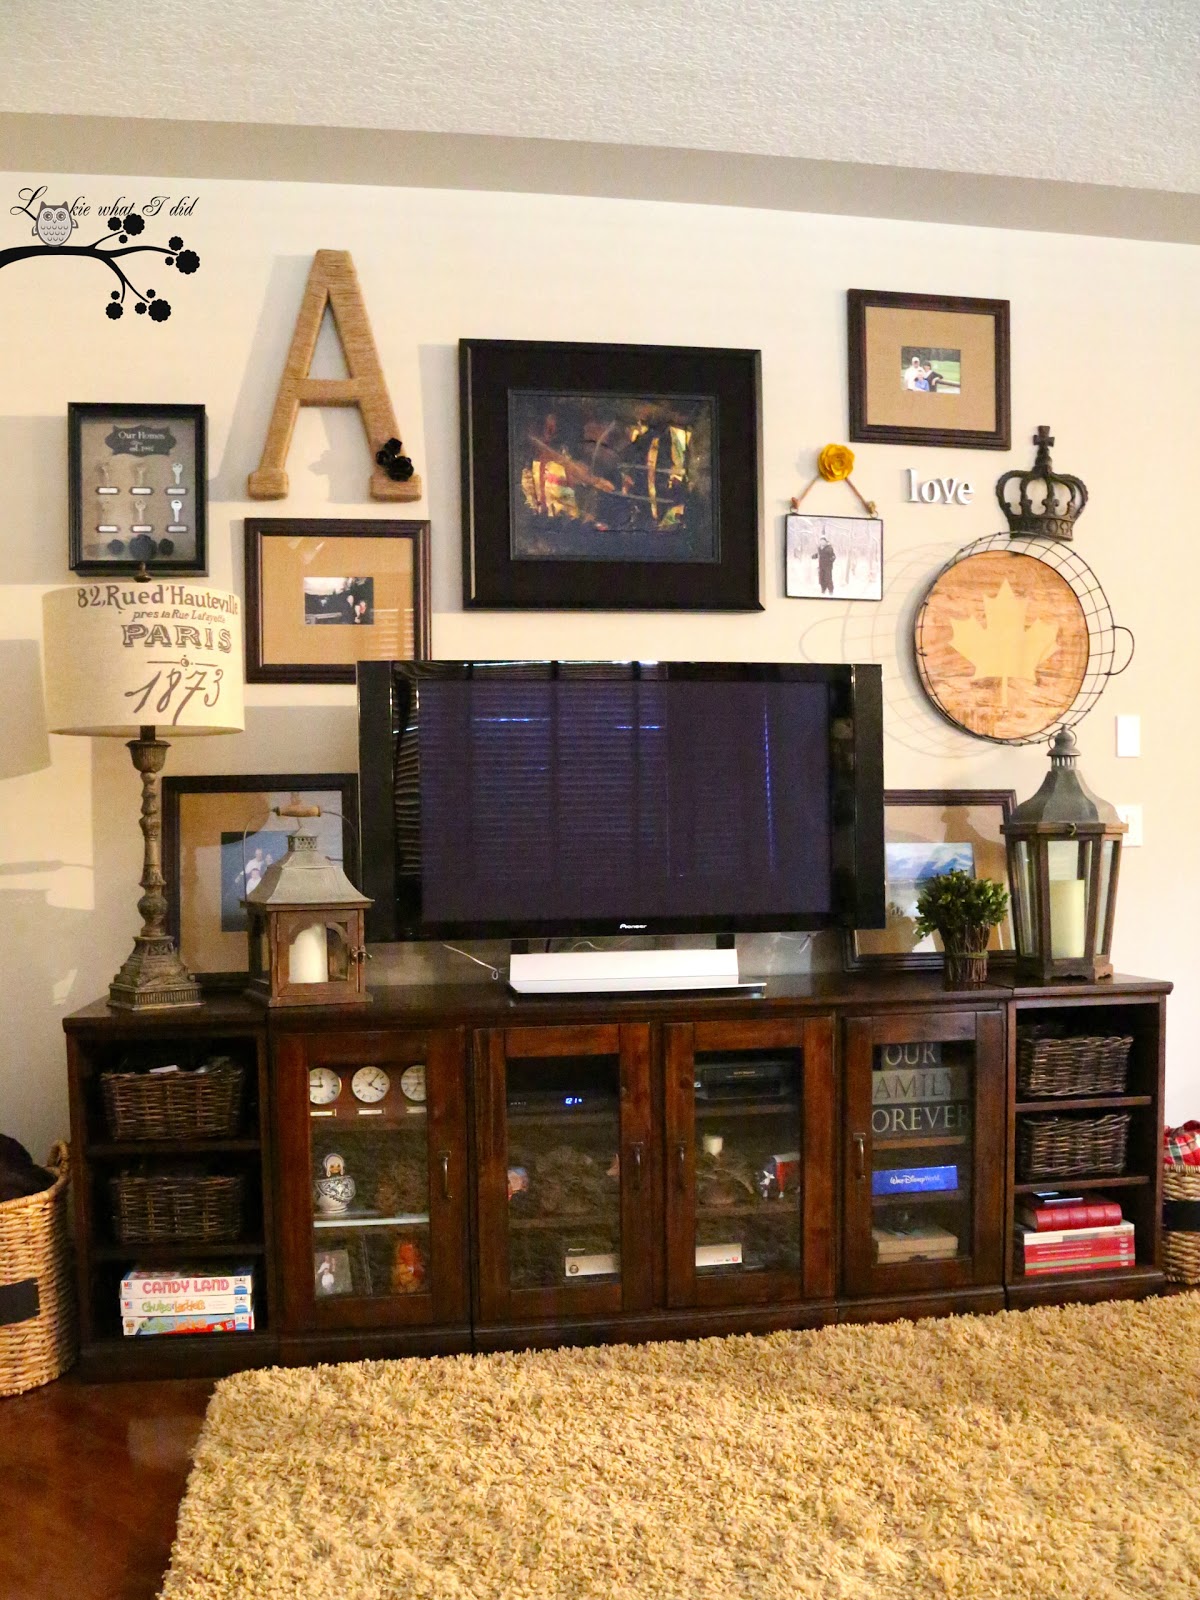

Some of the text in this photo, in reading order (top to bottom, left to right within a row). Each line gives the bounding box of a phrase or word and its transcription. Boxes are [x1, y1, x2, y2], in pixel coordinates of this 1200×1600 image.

[118, 431, 136, 439] Our
[905, 467, 974, 505] love
[171, 609, 189, 620] Rue
[121, 624, 232, 654] PARIS
[124, 668, 224, 726] 1873
[886, 1043, 937, 1066] OUR
[874, 1072, 951, 1099] AMIL
[872, 1103, 969, 1133] OREVER
[142, 1279, 190, 1294] CANDY
[194, 1278, 229, 1293] LAND
